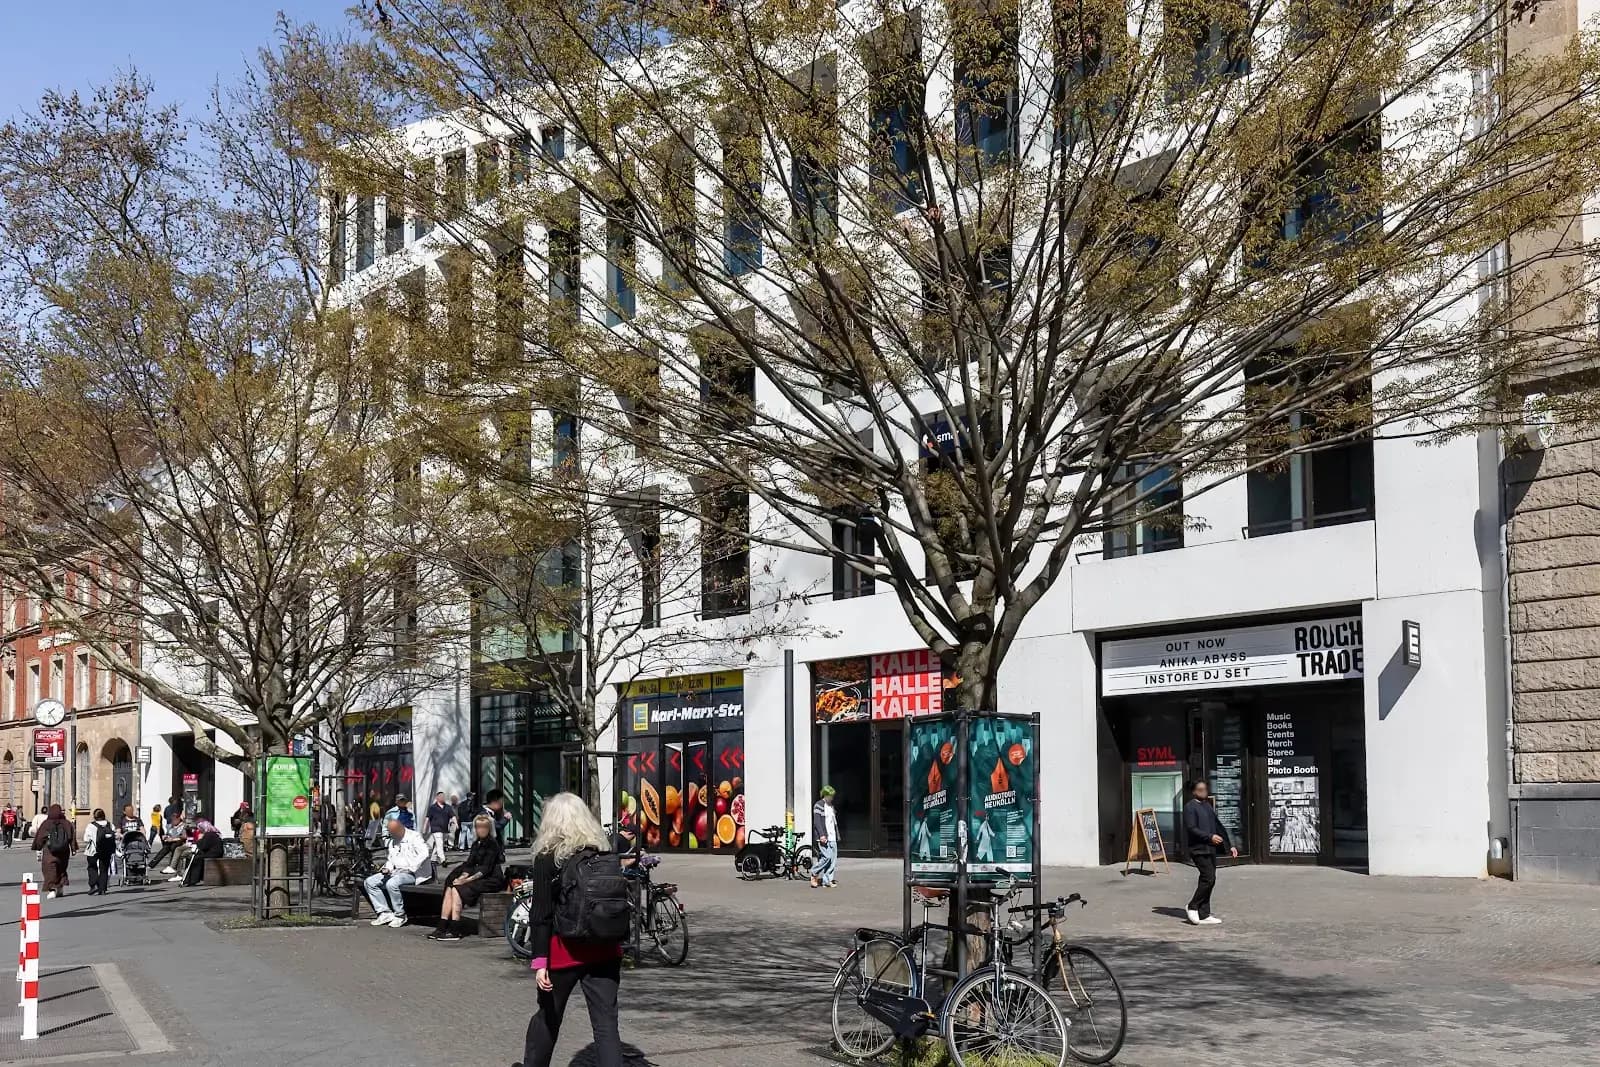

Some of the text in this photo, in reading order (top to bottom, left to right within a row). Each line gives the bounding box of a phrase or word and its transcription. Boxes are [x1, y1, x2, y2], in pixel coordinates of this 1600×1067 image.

[1166, 638, 1225, 652] OUT NOW
[1295, 621, 1362, 651] ROUGH
[872, 650, 941, 676] KALLE
[1160, 652, 1247, 668] ANIKA ABYSS
[1296, 648, 1363, 677] TRADE
[1145, 667, 1250, 685] INSTORE DJ SET
[872, 672, 941, 701] HALLE
[651, 703, 743, 723] Karl-Marx-Str.
[872, 694, 941, 719] KALLE
[1267, 722, 1292, 730] Books
[1137, 746, 1176, 760] SYML
[1294, 766, 1319, 774] Booth
[985, 791, 1016, 803] AUDIOTOUR
